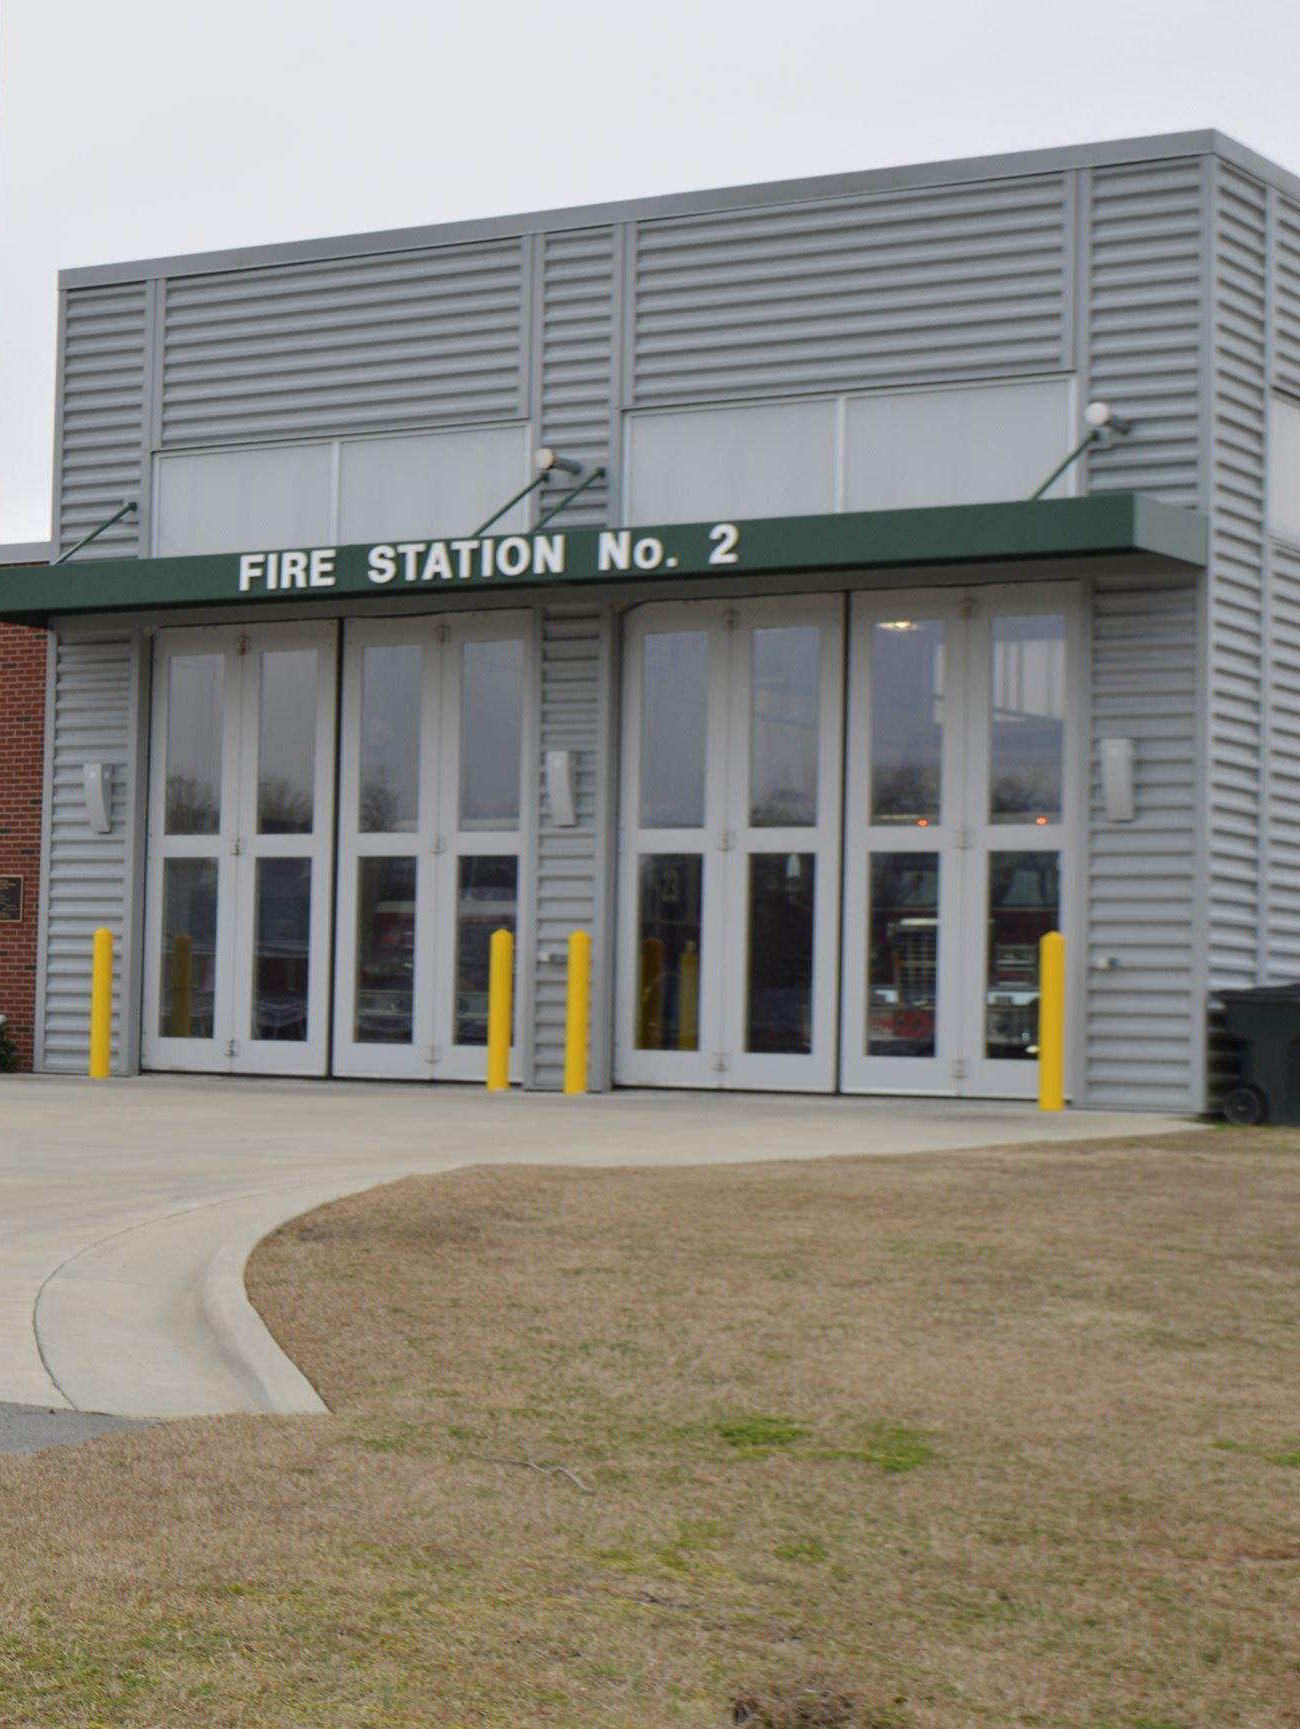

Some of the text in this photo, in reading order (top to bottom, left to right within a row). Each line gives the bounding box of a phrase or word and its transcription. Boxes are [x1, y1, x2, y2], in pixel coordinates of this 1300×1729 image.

[238, 523, 740, 592] FIRE STATION No. 2
